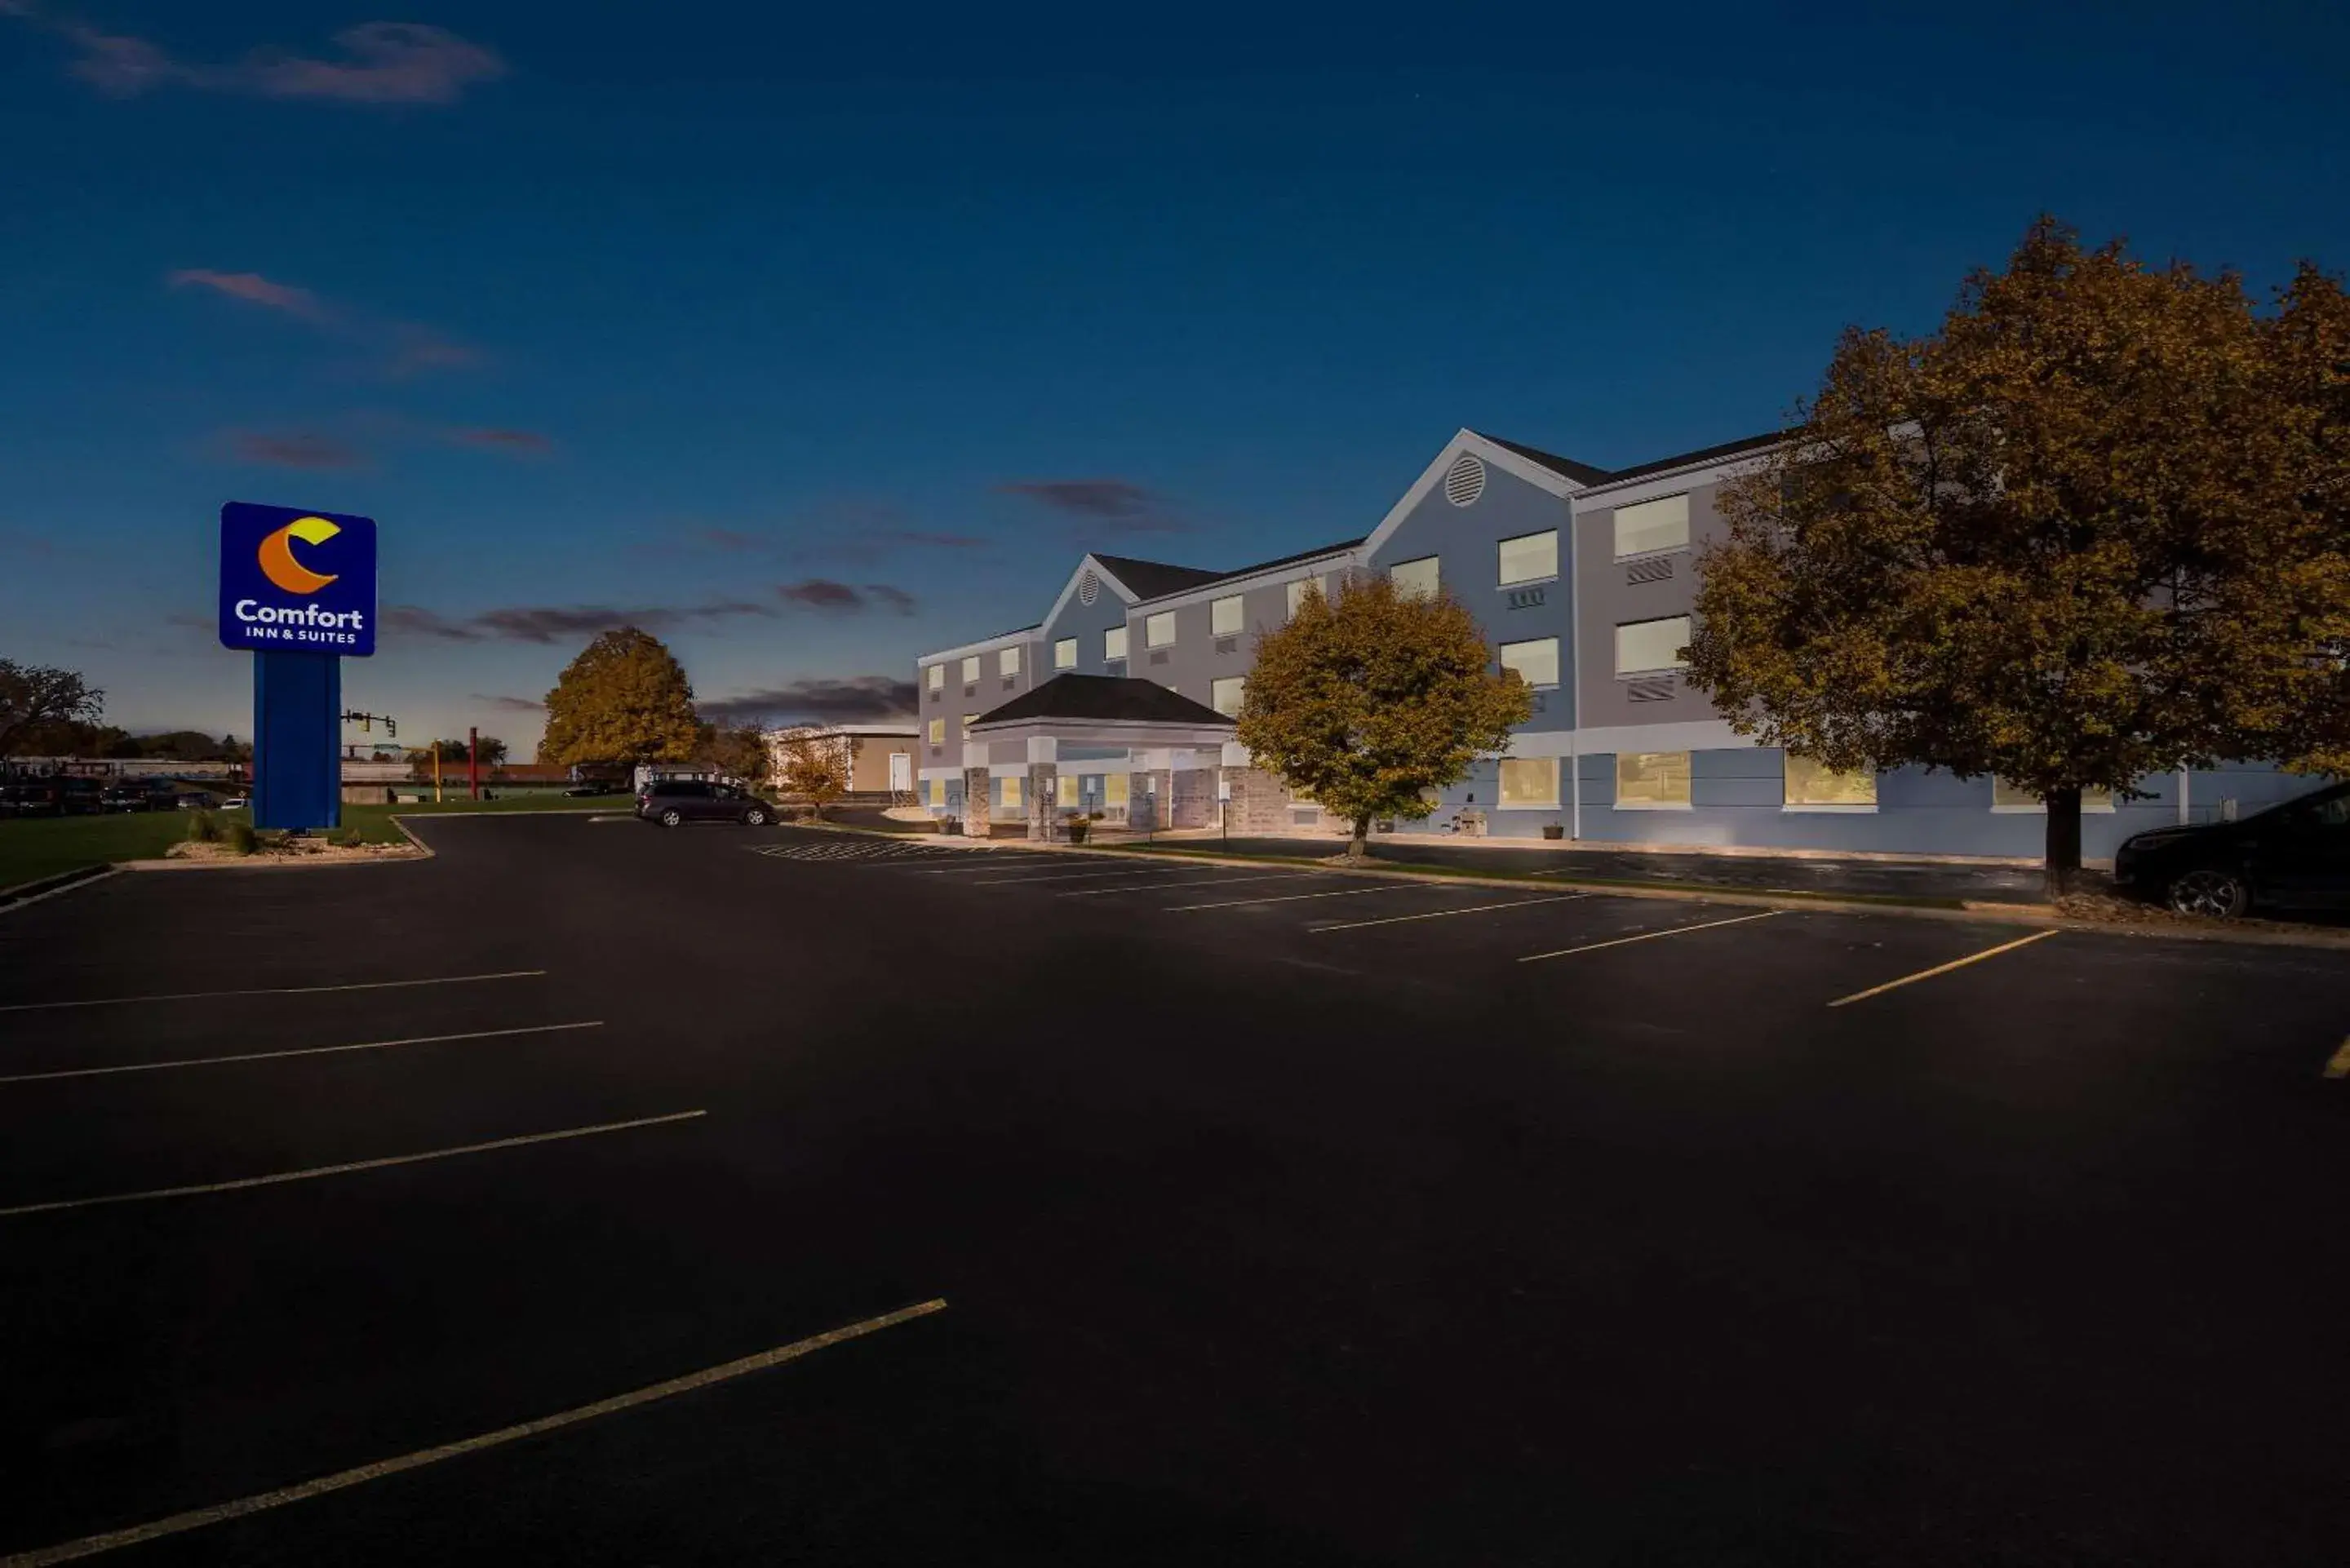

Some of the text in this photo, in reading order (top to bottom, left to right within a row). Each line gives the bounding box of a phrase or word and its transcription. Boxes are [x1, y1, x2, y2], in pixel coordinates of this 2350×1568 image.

[234, 599, 363, 630] Comfort
[245, 626, 357, 644] INN & SUITES
